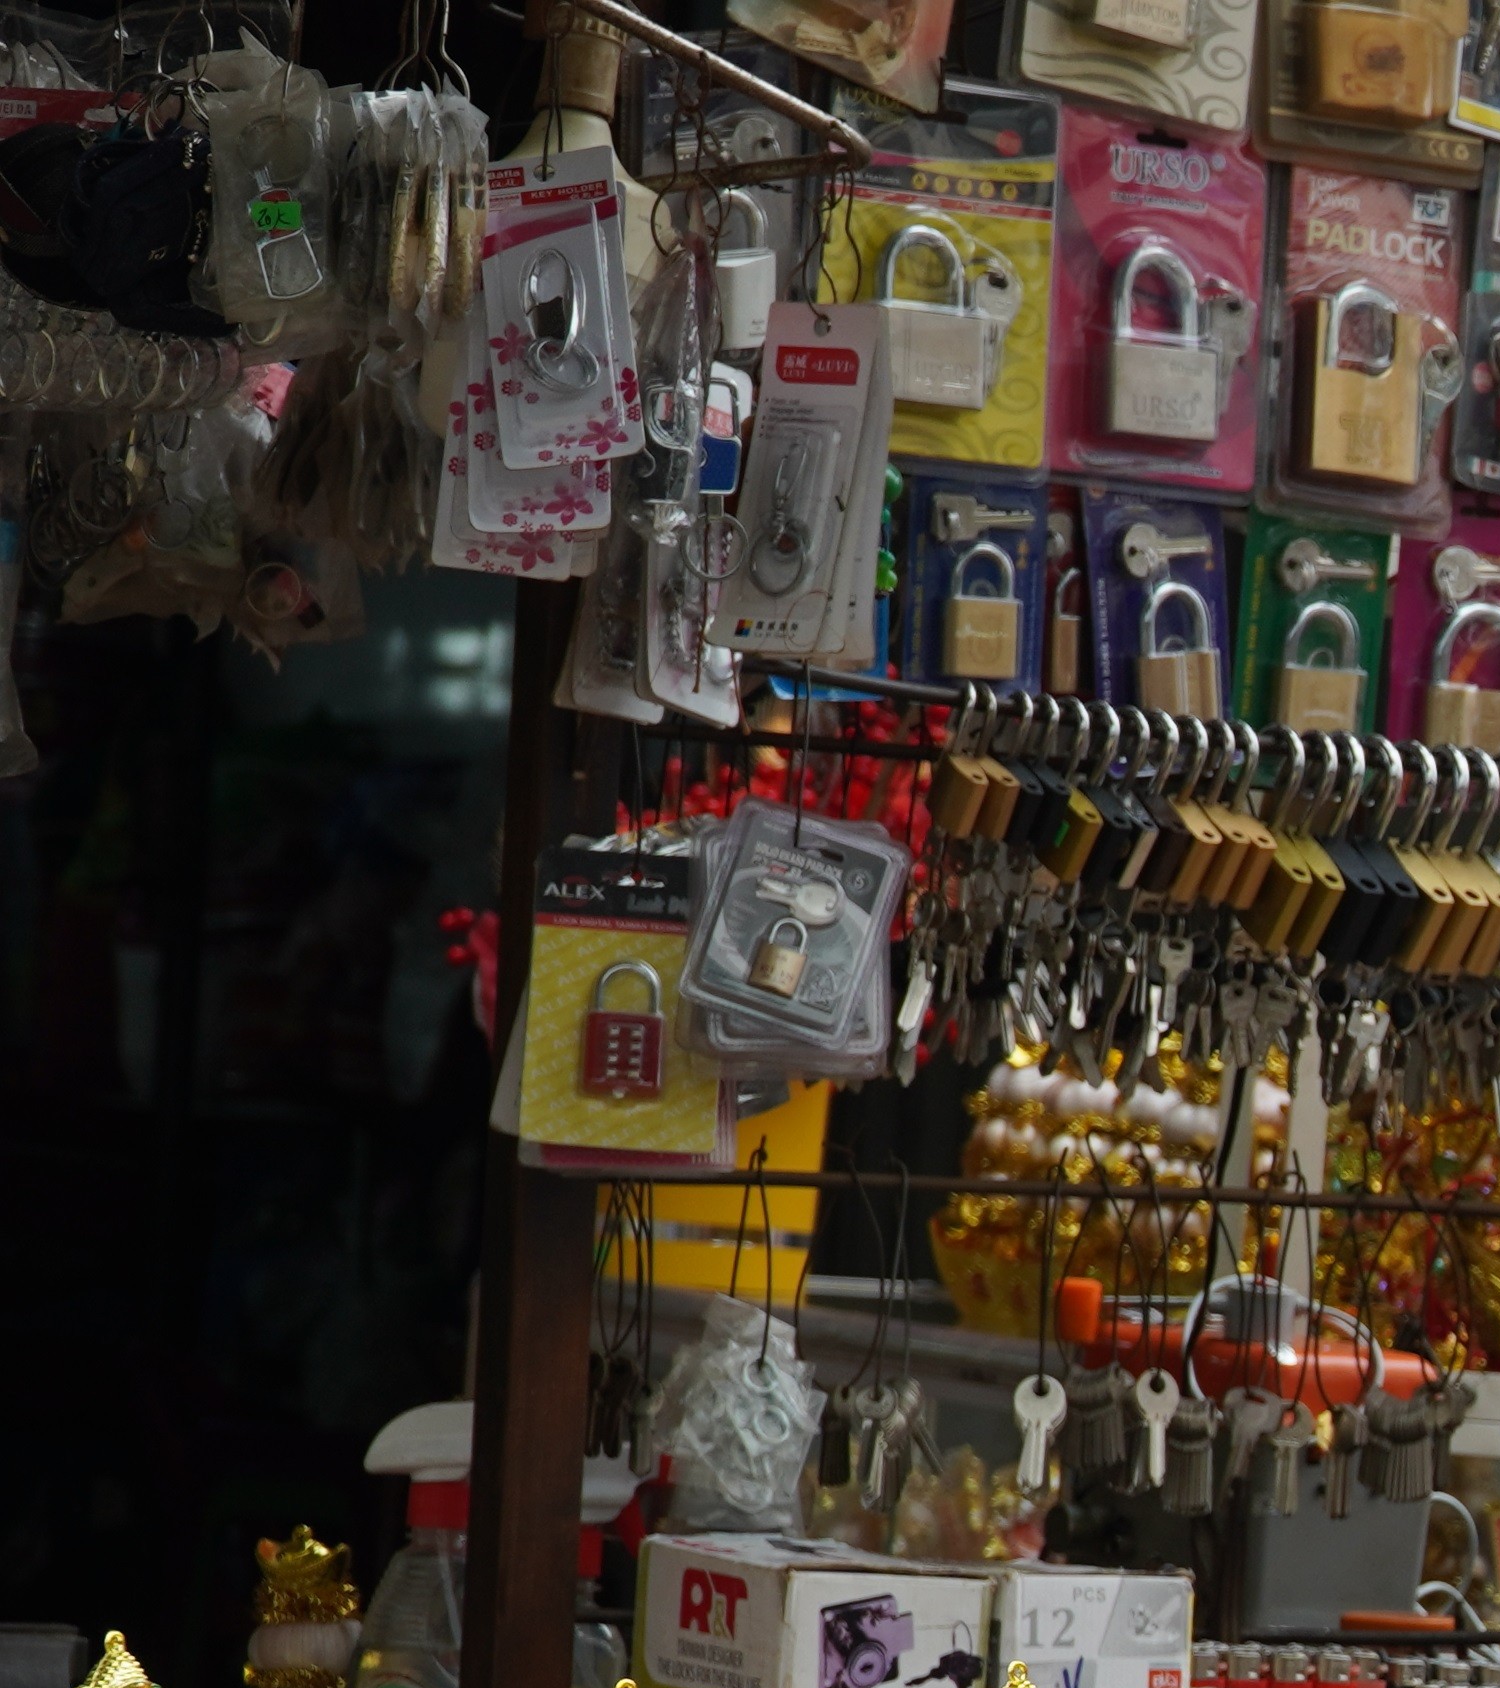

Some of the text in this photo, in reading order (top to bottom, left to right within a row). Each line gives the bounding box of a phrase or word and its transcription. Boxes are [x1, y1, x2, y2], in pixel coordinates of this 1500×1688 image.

[1110, 144, 1210, 191] URSO
[531, 188, 553, 199] KEY
[557, 182, 605, 196] HOLDER
[1307, 219, 1446, 268] PADLOCK
[1132, 392, 1196, 422] URSO
[543, 880, 606, 901] ALEX
[1072, 1587, 1107, 1602] PCS
[1022, 1607, 1077, 1650] 12
